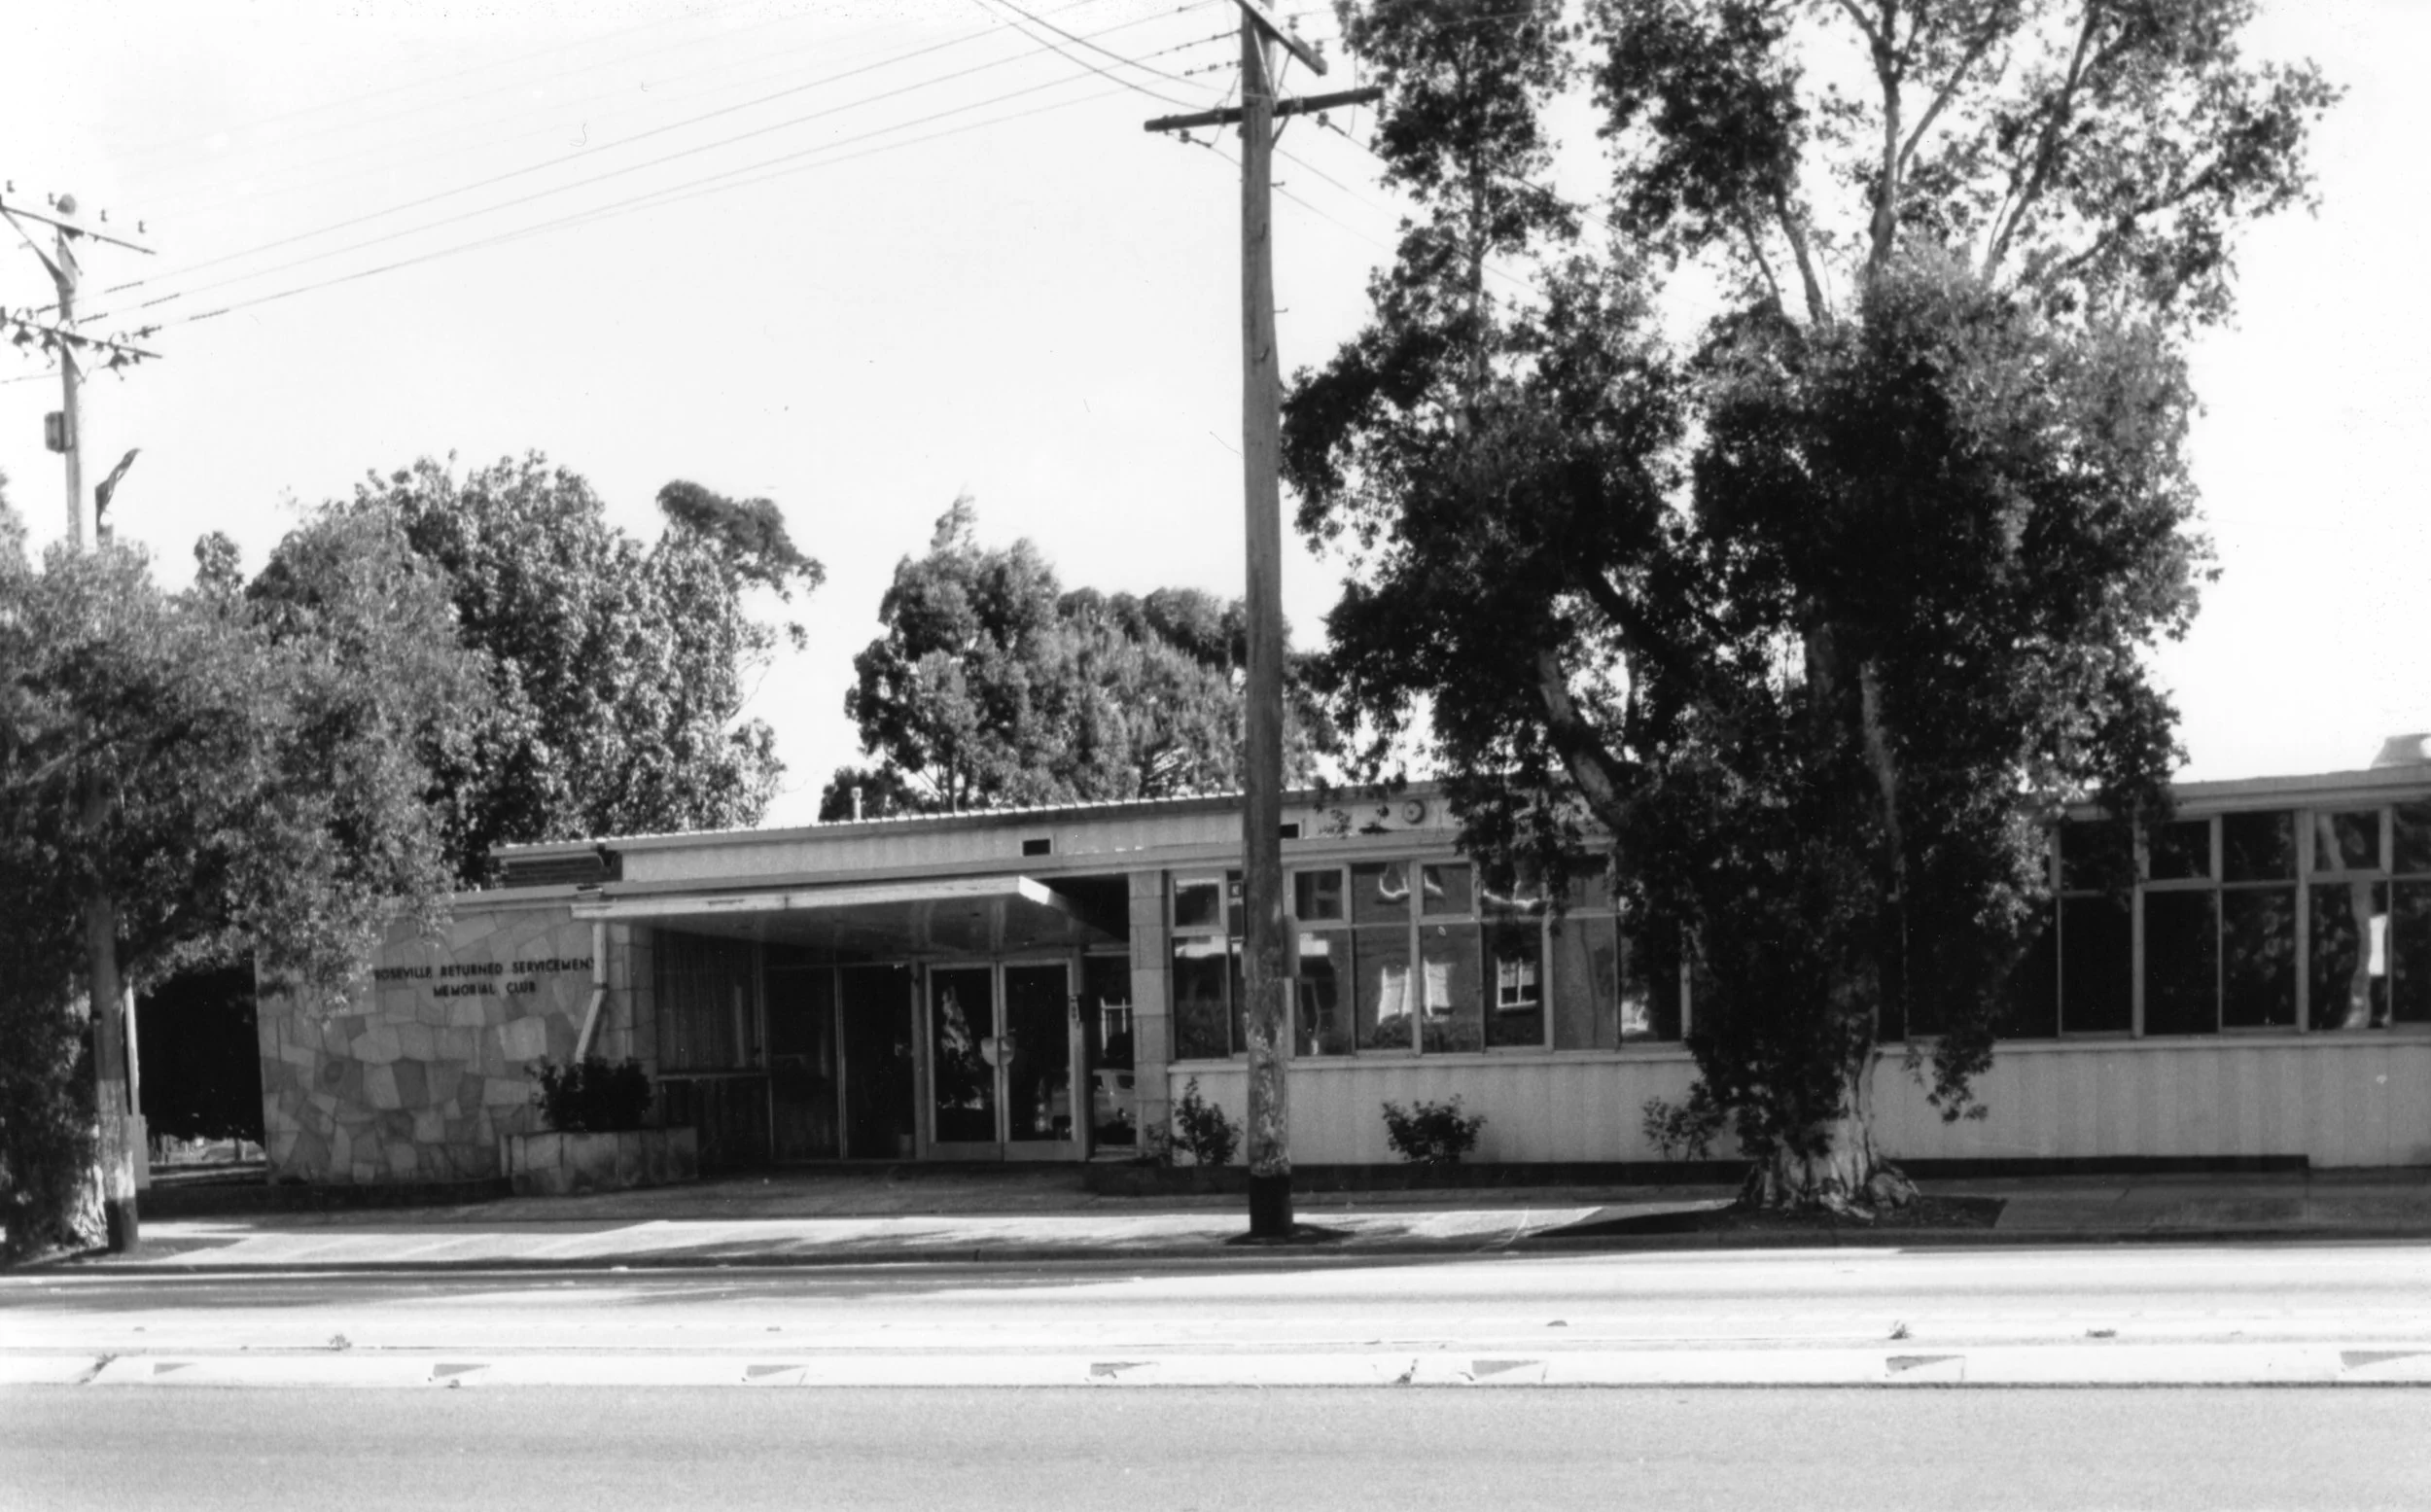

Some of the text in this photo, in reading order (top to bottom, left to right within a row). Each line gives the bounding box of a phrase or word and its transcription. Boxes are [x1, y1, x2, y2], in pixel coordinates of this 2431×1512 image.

[440, 962, 504, 978] RETURNED
[433, 980, 537, 998] MEMORIAL CLUB
